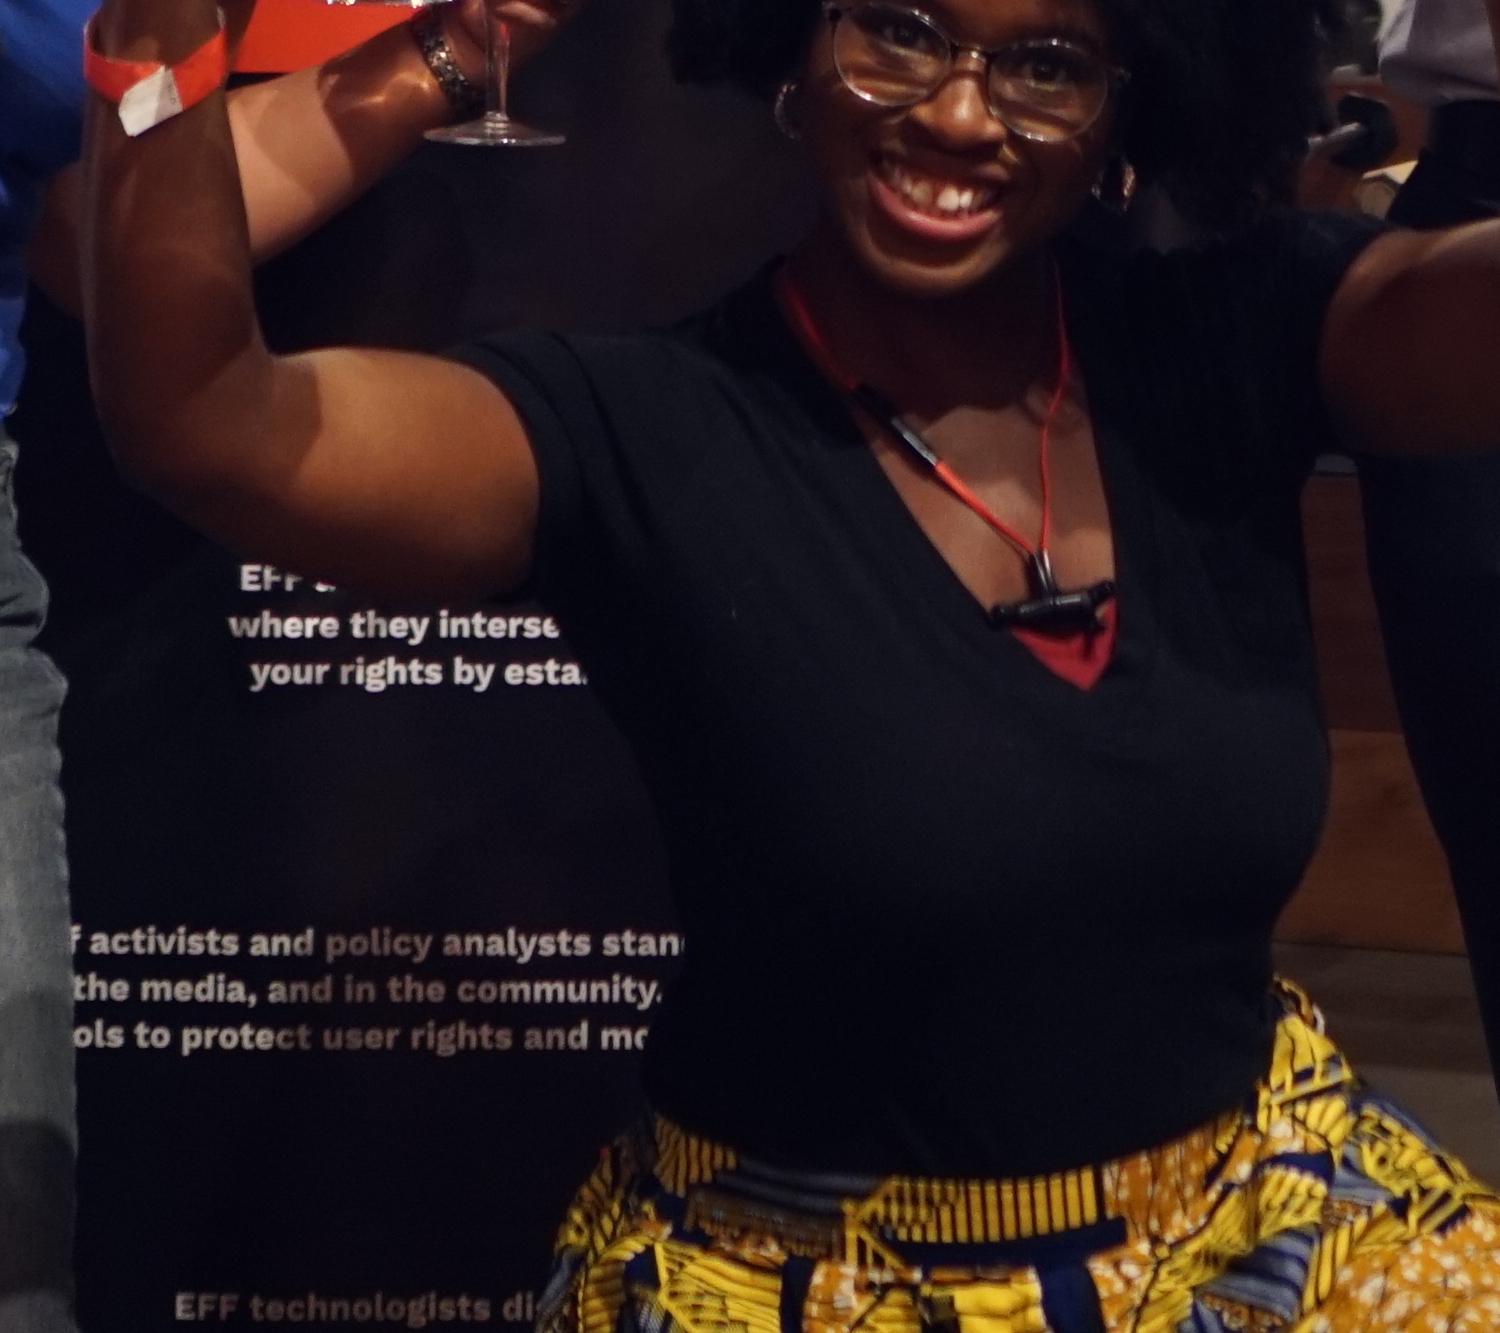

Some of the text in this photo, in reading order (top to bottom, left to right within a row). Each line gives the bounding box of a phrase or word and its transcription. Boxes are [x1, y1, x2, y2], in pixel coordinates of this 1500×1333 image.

[229, 611, 340, 639] where
[350, 611, 431, 646] they
[252, 657, 588, 693] your rights by esta
[91, 926, 240, 957] activists
[250, 929, 315, 957] and
[327, 928, 434, 964] policy
[445, 927, 592, 965] analysts
[603, 930, 685, 957] stan
[73, 972, 130, 1002] the
[142, 974, 258, 1009] media,
[269, 976, 333, 1004] and
[346, 976, 376, 1003] in
[388, 976, 446, 1003] the
[135, 1023, 172, 1049] to
[182, 1024, 311, 1057] protect
[324, 1029, 401, 1050] user
[412, 1021, 513, 1057] rights
[525, 1020, 589, 1051] and
[176, 1293, 542, 1328] EFF technologists di
